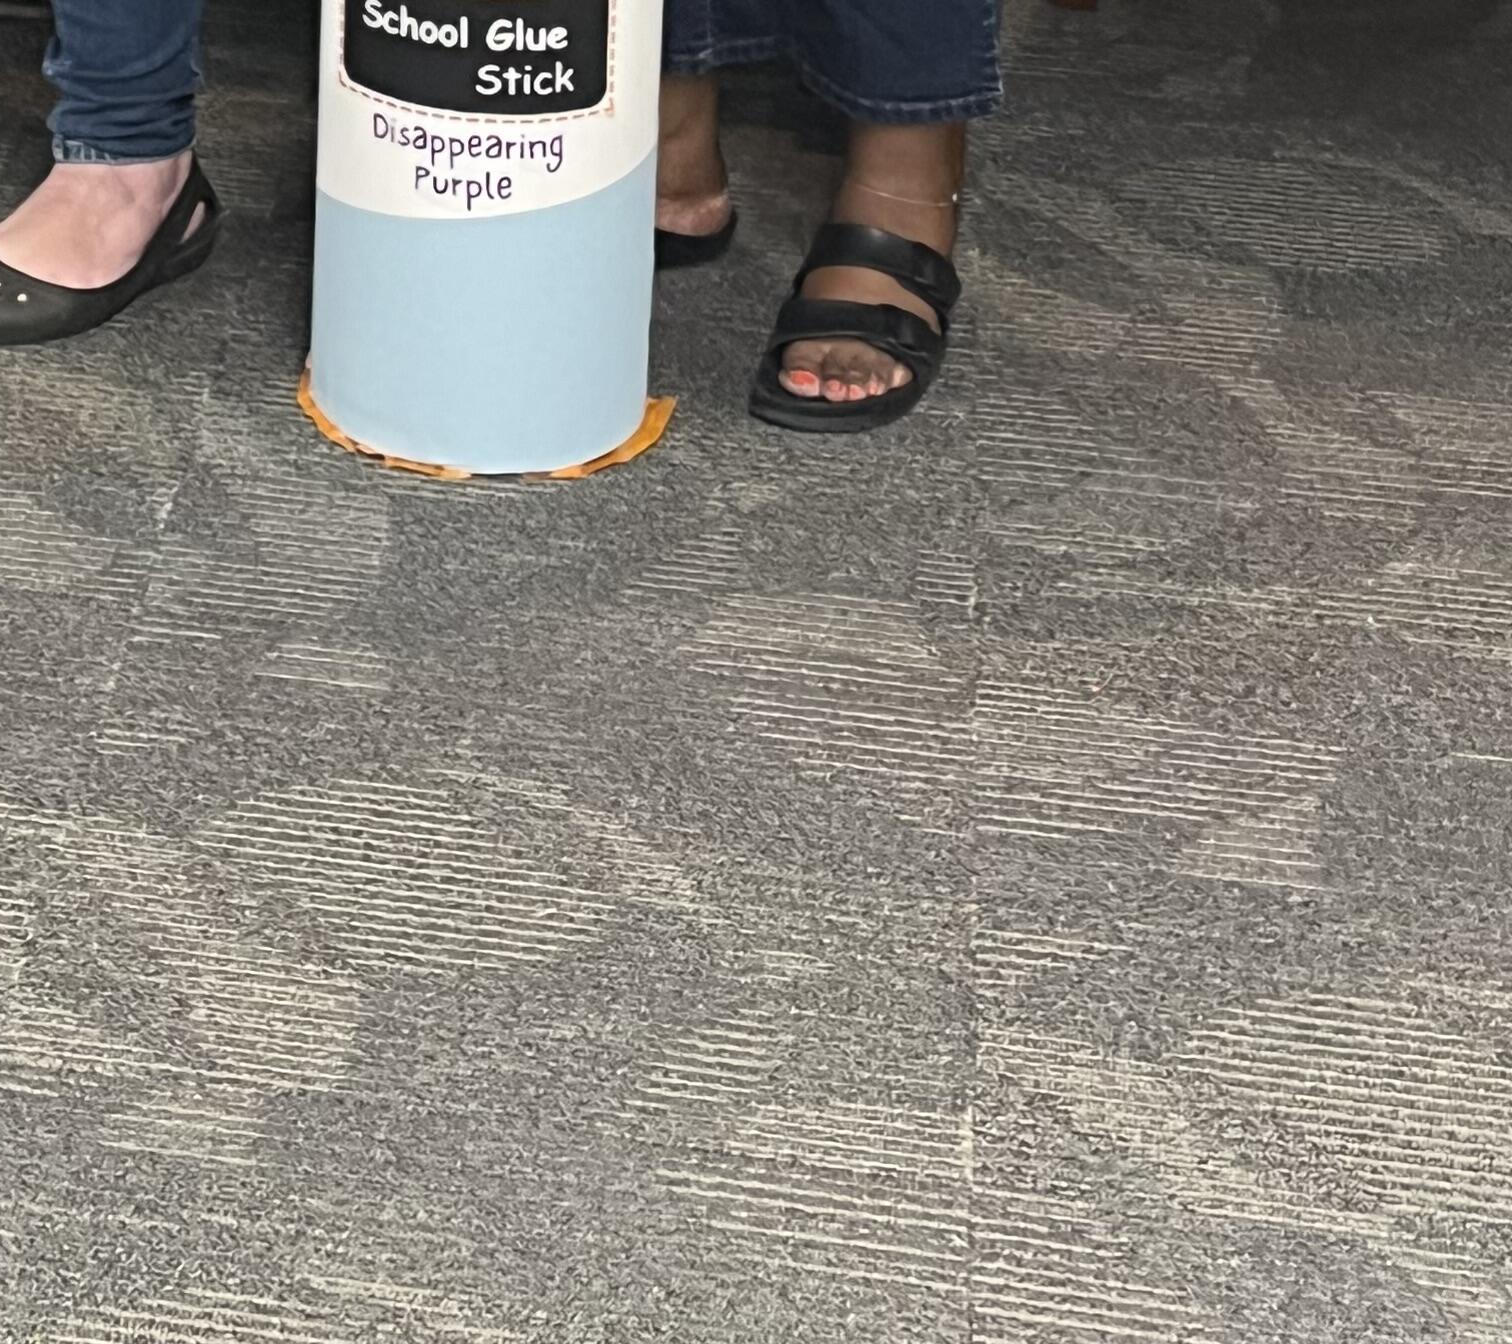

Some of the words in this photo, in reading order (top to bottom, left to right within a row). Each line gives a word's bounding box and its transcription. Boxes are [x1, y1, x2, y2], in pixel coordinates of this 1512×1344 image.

[485, 17, 569, 53] Glue
[474, 62, 575, 97] Stick
[372, 112, 565, 173] Disappearing
[414, 165, 514, 211] Purple
